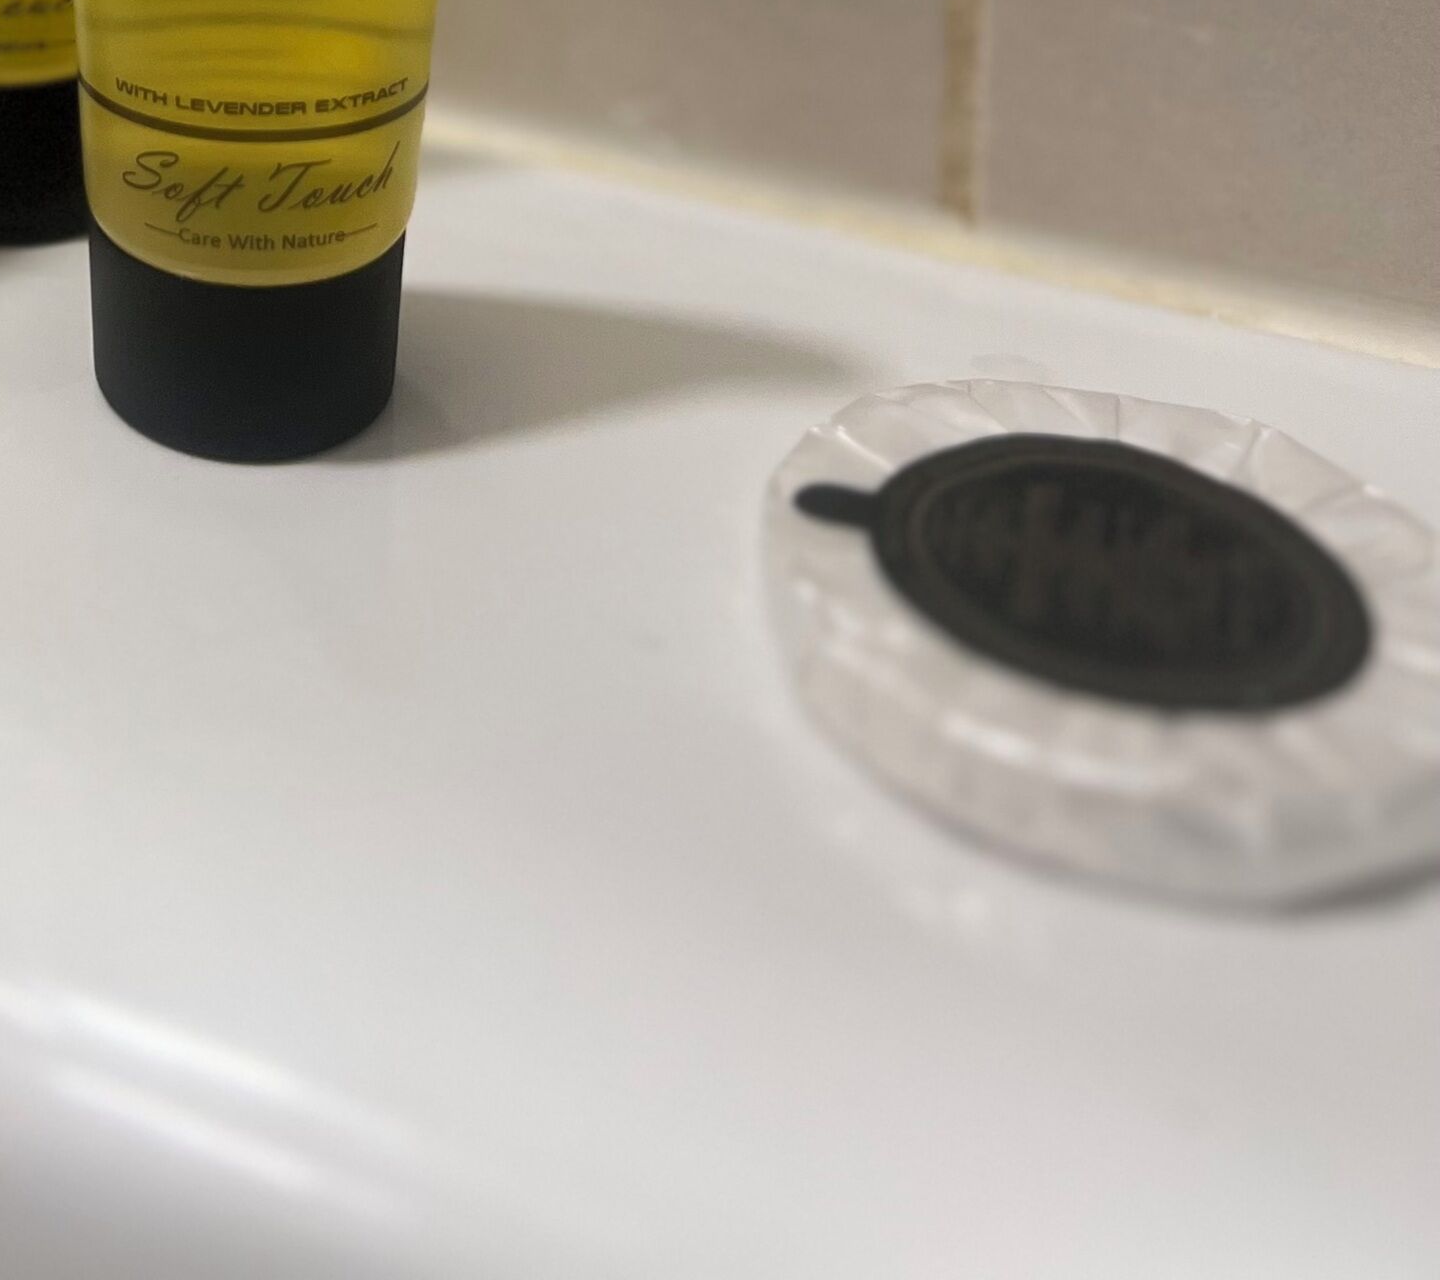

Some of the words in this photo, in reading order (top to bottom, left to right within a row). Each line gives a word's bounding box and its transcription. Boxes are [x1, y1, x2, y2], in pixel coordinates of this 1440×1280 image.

[115, 76, 168, 107] WITH
[175, 95, 308, 116] LEVENDER
[314, 76, 409, 114] EXTRACT
[122, 150, 246, 223] Soft
[257, 140, 402, 213] Touch
[178, 227, 222, 249] Care
[227, 232, 276, 252] With
[281, 227, 346, 250] Nature
